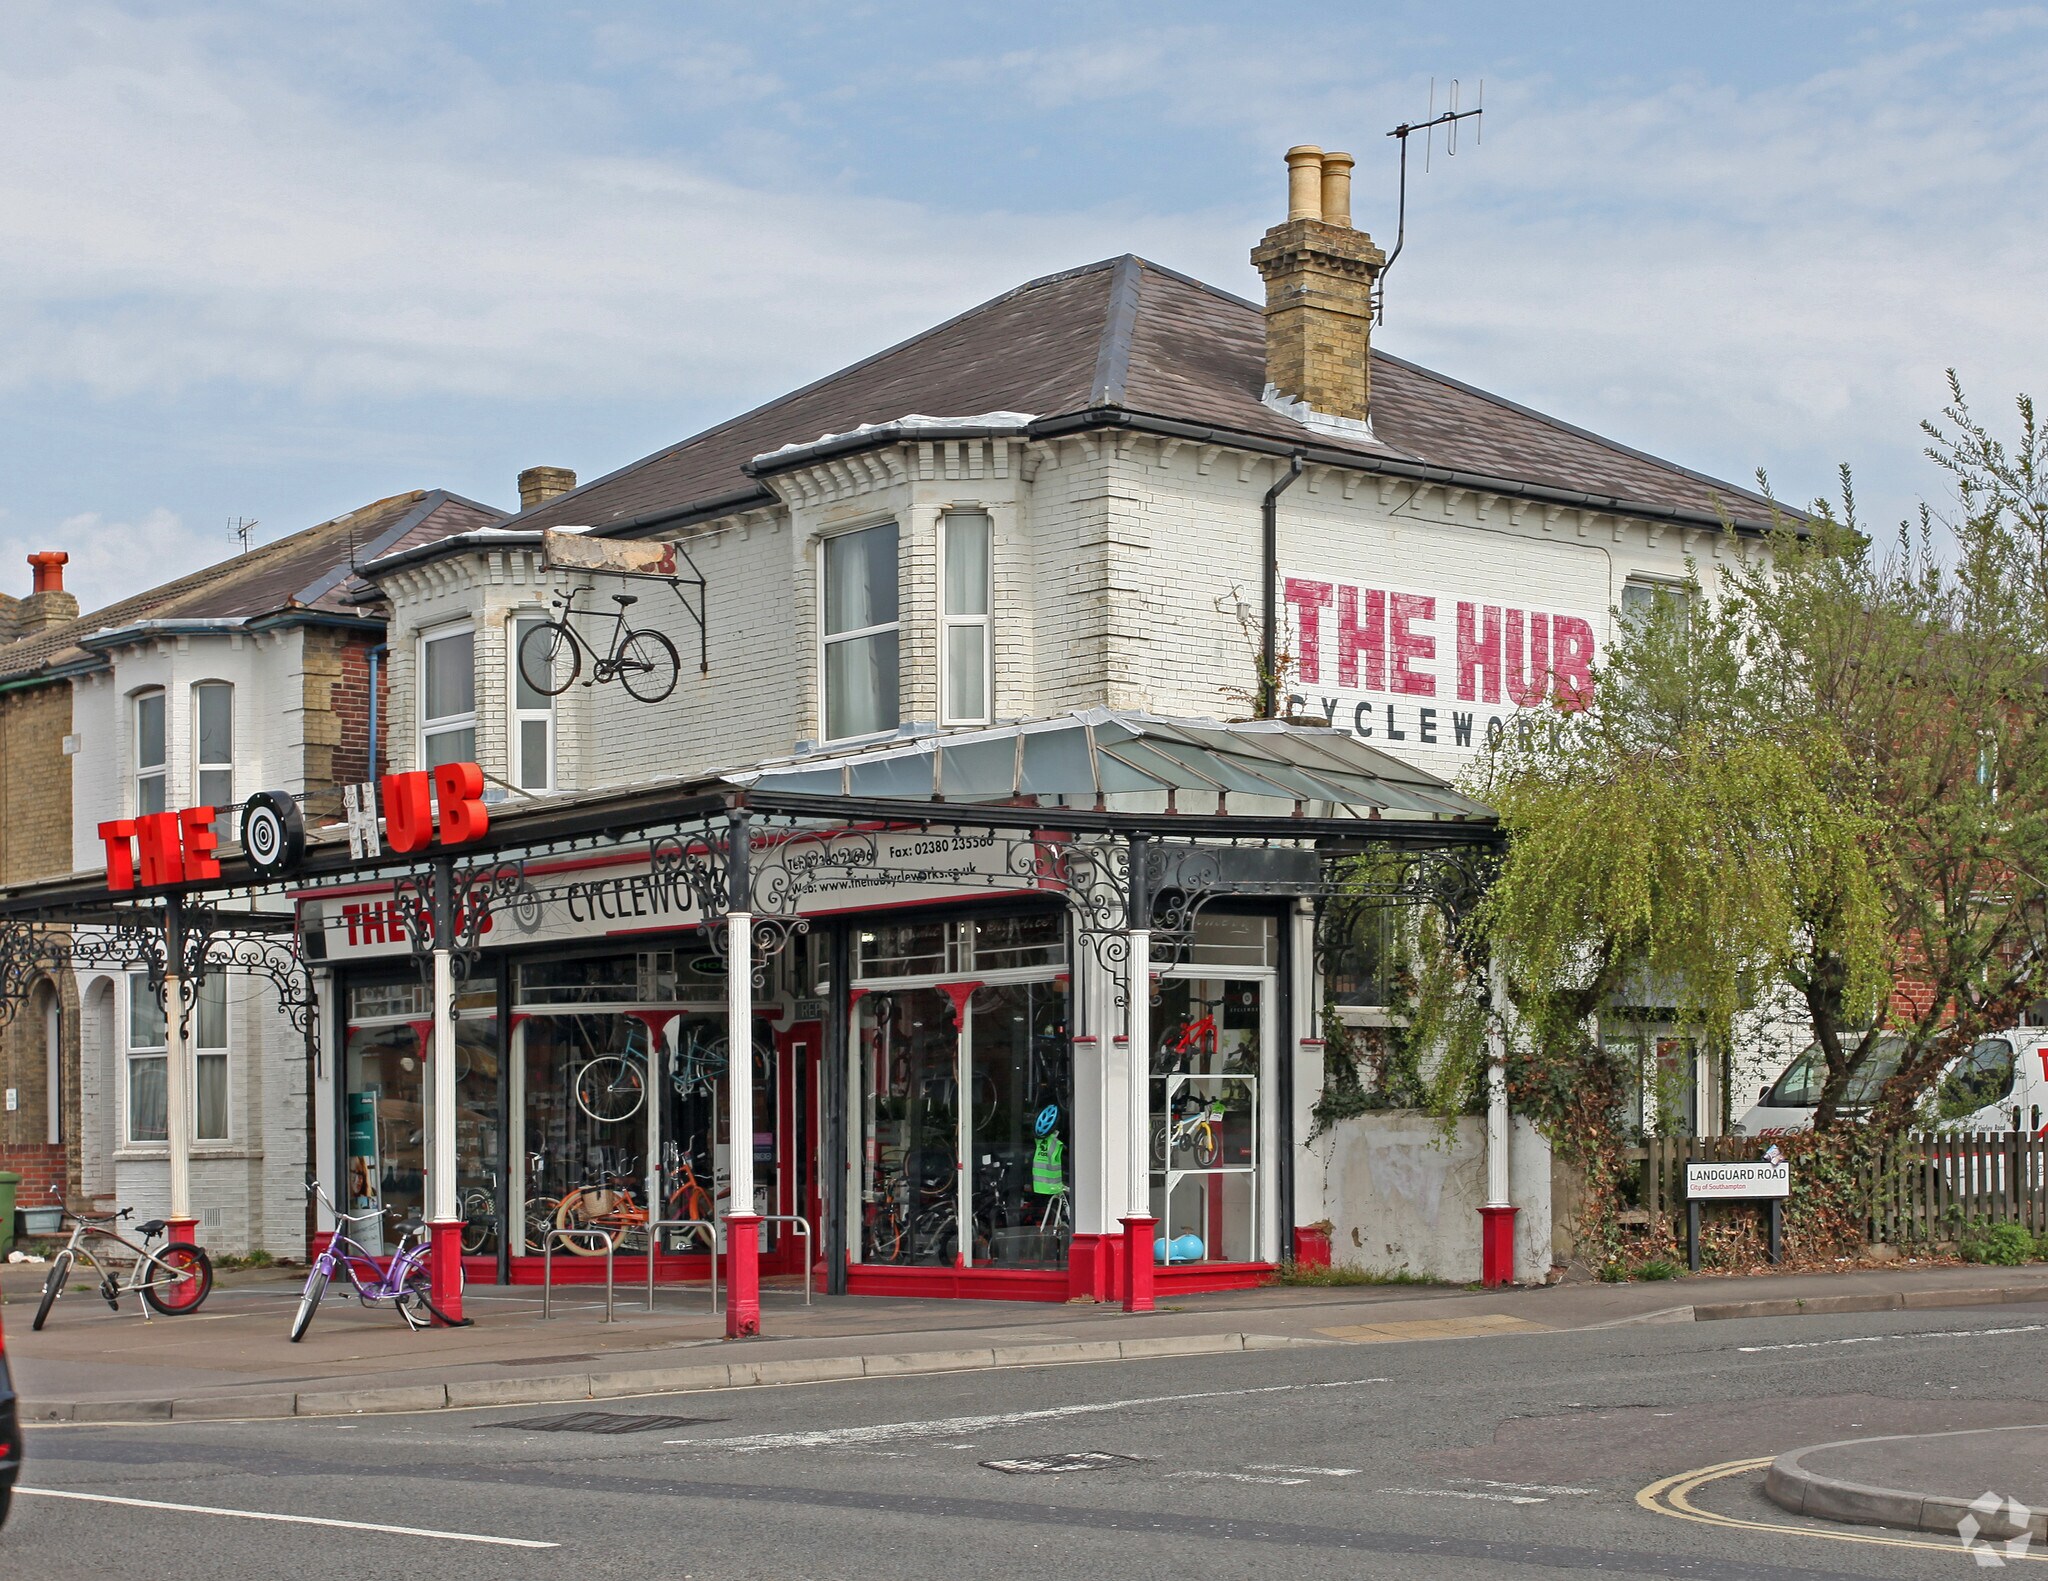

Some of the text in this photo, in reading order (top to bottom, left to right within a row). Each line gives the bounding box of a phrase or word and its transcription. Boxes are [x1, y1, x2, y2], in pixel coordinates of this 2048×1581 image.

[1285, 577, 1595, 713] THE HUB
[1285, 694, 1599, 756] YCLEWORK
[98, 762, 489, 891] THE HUB
[889, 846, 912, 858] Fax:
[915, 839, 949, 855] 02380
[792, 880, 817, 894] Web:
[342, 900, 406, 946] THE
[1994, 1123, 2006, 1131] Road
[1690, 1168, 1786, 1181] LANDGUARD ROAD
[1690, 1183, 1702, 1191] City
[1709, 1183, 1746, 1191] Southampton
